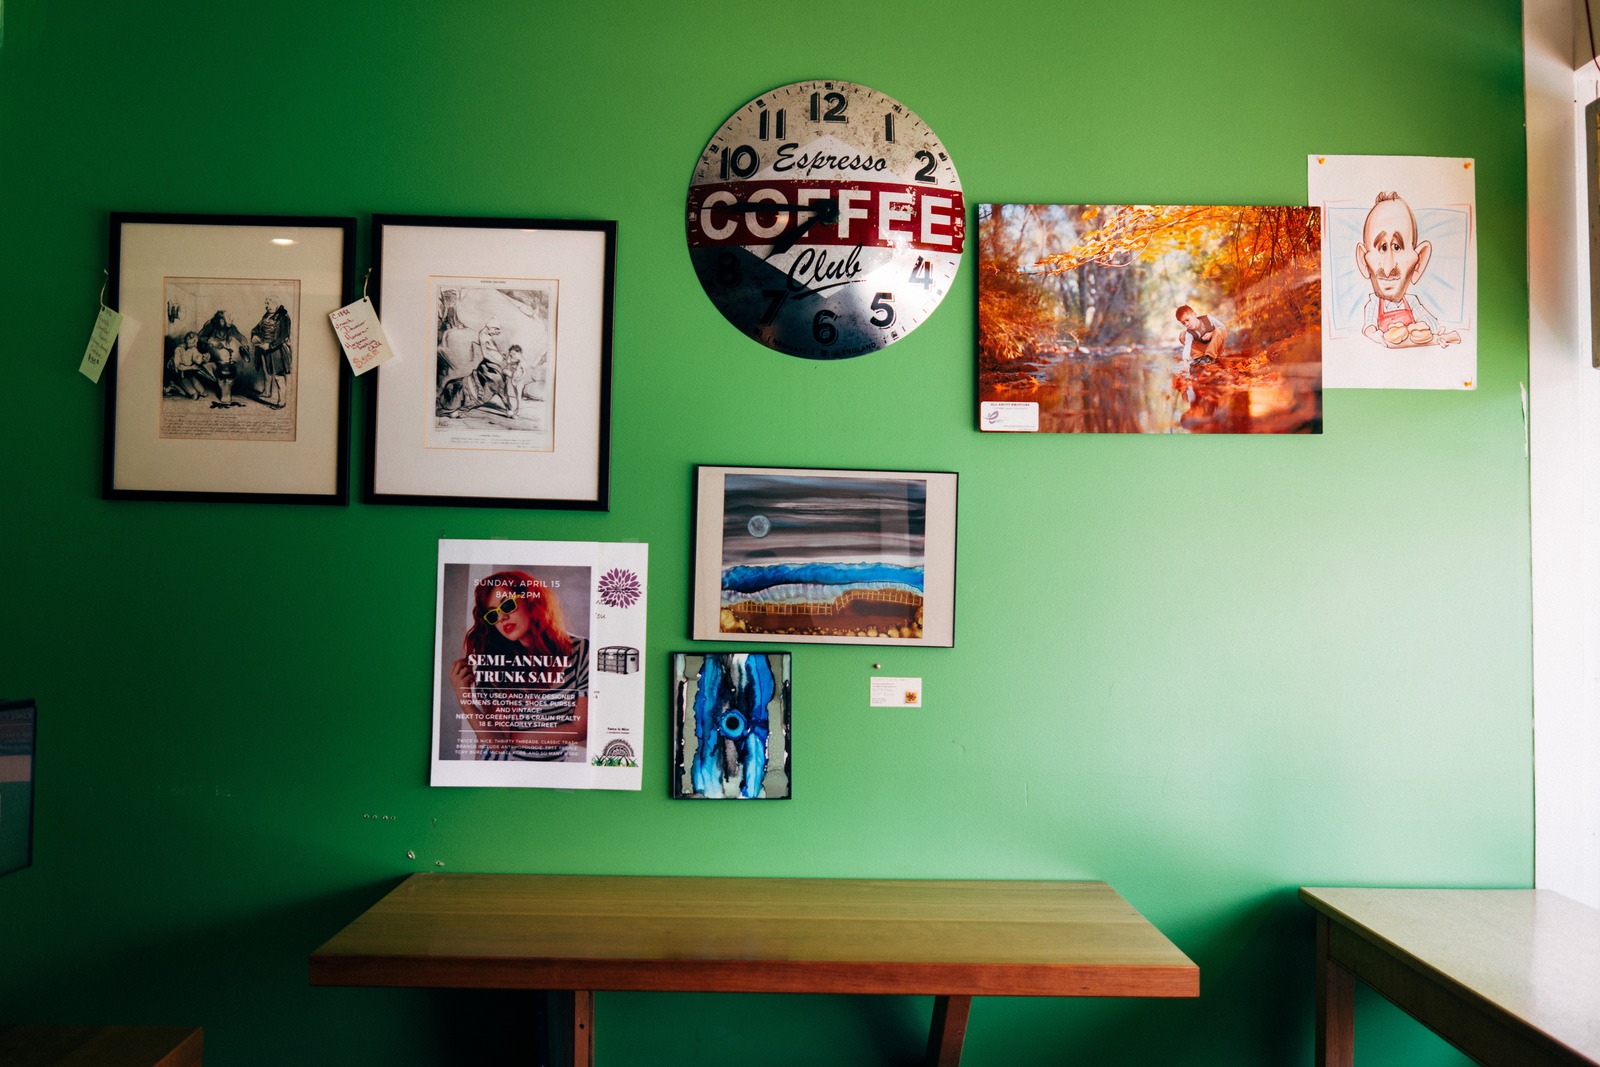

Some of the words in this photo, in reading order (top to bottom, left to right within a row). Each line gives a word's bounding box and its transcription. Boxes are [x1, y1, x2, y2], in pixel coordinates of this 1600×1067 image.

[809, 91, 848, 123] 12
[759, 108, 786, 141] 11
[884, 112, 895, 143] 1
[719, 144, 760, 180] 10
[772, 143, 887, 176] Espresso
[914, 150, 938, 185] 2
[700, 188, 953, 246] COFFEE
[715, 250, 741, 287] 8
[787, 242, 862, 293] Club
[908, 255, 935, 291] 4
[761, 289, 790, 326] 7
[869, 291, 897, 329] 5
[812, 309, 839, 346] 6
[841, 341, 877, 354] ENGLAND
[473, 579, 517, 588] SUNDAY,
[519, 580, 548, 588] APRIL
[551, 580, 561, 588] 15
[467, 654, 572, 667] SEMI-ANNUAL
[474, 670, 525, 683] TRUNK
[528, 671, 565, 684] SALE
[556, 714, 582, 722] REALTY
